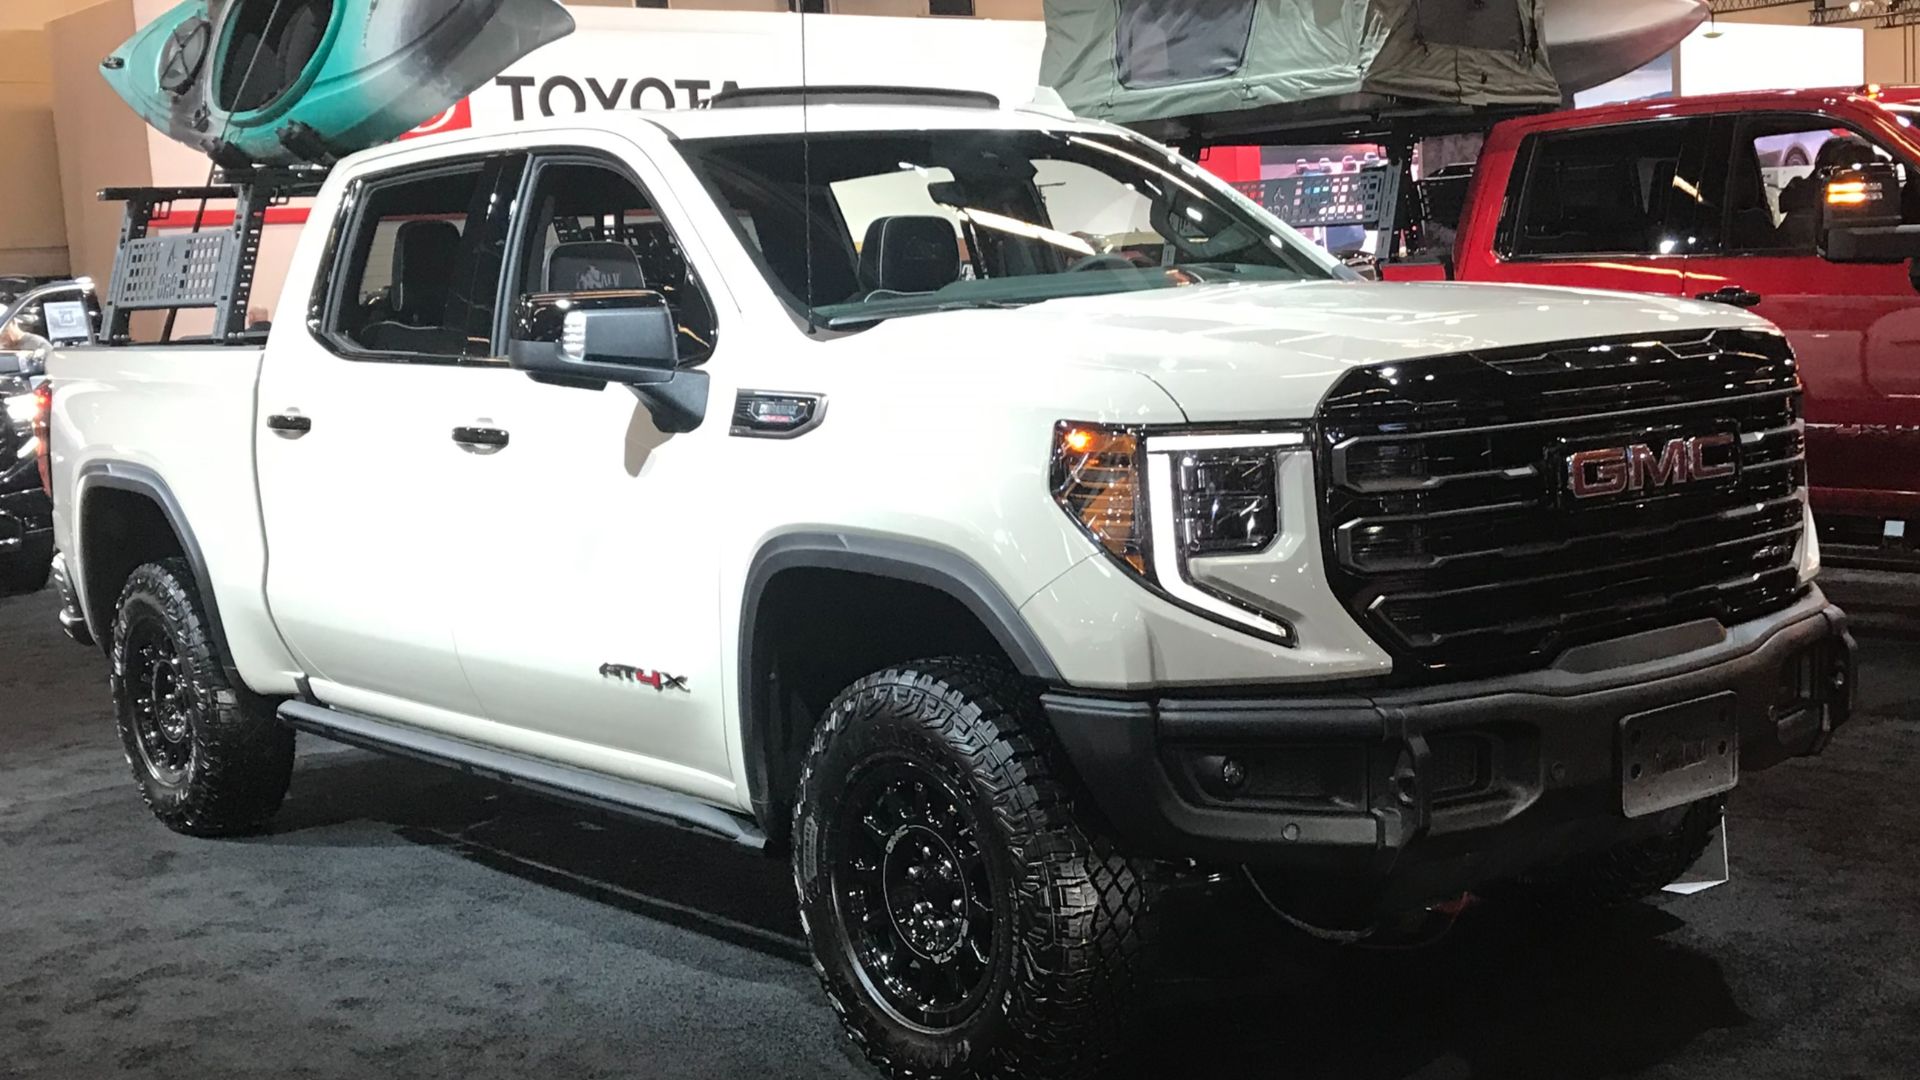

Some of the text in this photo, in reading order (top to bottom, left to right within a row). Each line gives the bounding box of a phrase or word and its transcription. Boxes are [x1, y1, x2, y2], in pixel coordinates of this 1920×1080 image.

[495, 75, 739, 121] TOYOT
[1566, 432, 1736, 499] GMC
[599, 662, 691, 693] AT4X
